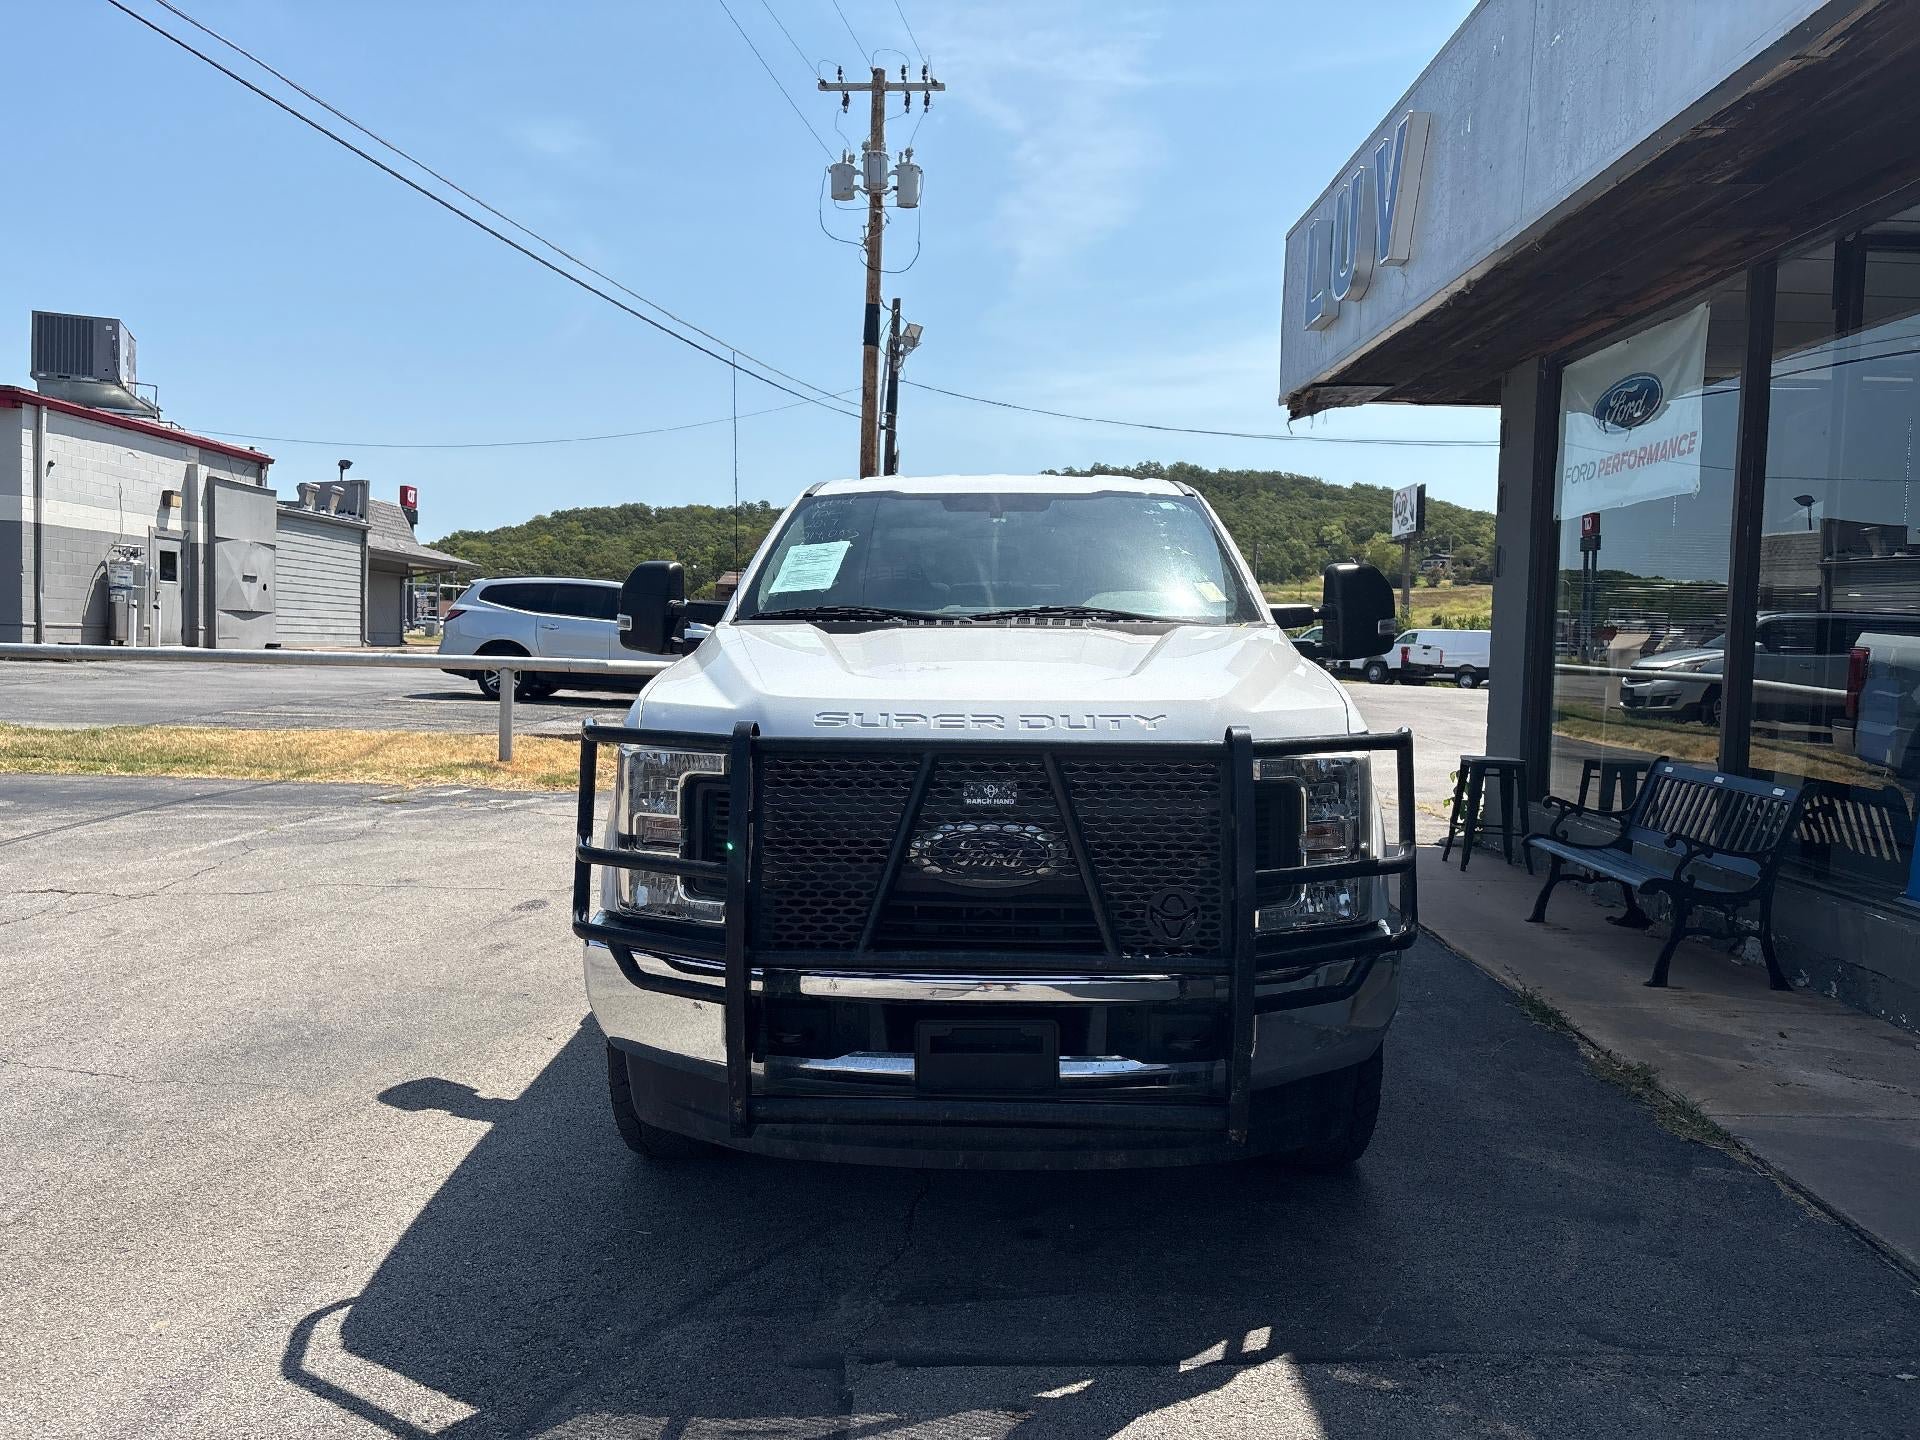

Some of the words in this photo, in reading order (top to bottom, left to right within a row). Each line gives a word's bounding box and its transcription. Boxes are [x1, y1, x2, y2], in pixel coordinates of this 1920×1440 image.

[1304, 110, 1431, 331] LUV
[1605, 383, 1650, 422] Ford
[1564, 461, 1597, 486] FORD
[1598, 431, 1698, 478] PERFORMANCE
[813, 711, 1005, 731] SUPER
[1018, 713, 1167, 731] DUTY
[952, 841, 1024, 867] Ford
